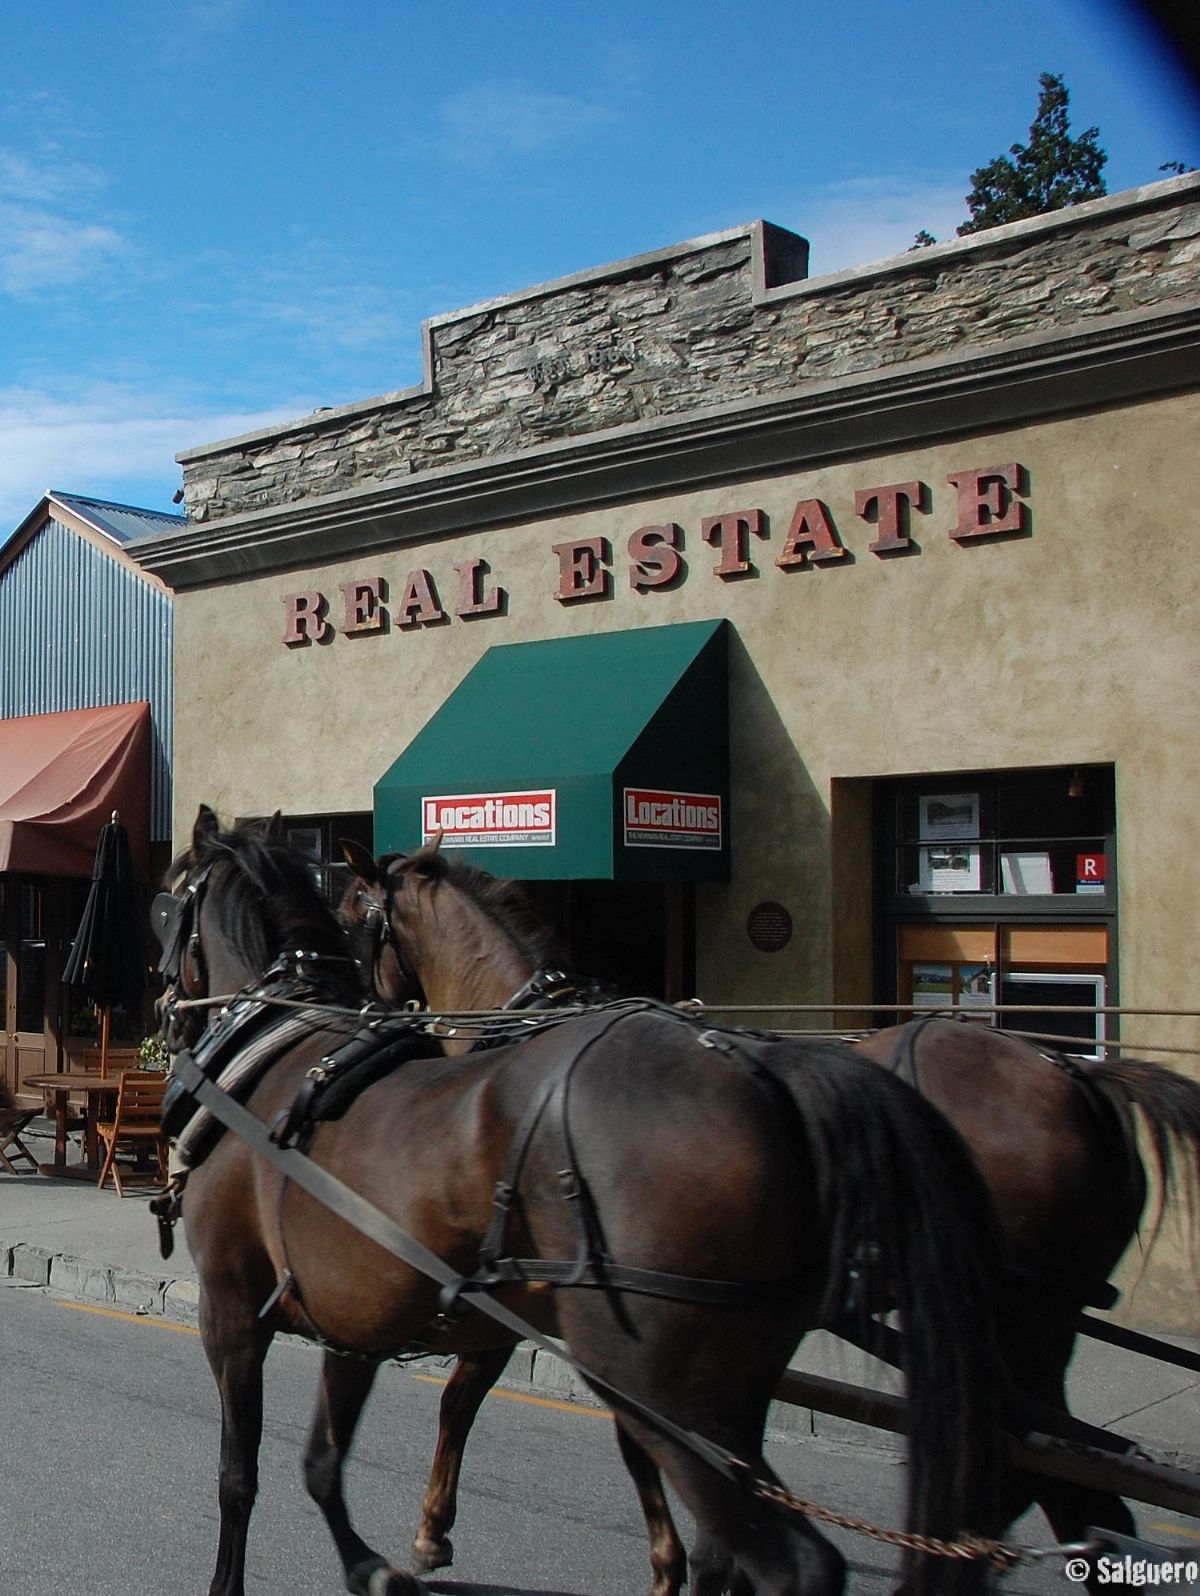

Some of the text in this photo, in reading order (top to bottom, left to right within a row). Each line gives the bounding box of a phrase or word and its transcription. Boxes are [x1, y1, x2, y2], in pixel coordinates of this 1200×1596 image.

[282, 462, 1030, 645] REAL ESTATE
[426, 799, 550, 830] Locations
[627, 795, 718, 829] Locations
[480, 835, 499, 843] ESTATE
[499, 833, 528, 842] COMPANY
[1084, 858, 1098, 876] R
